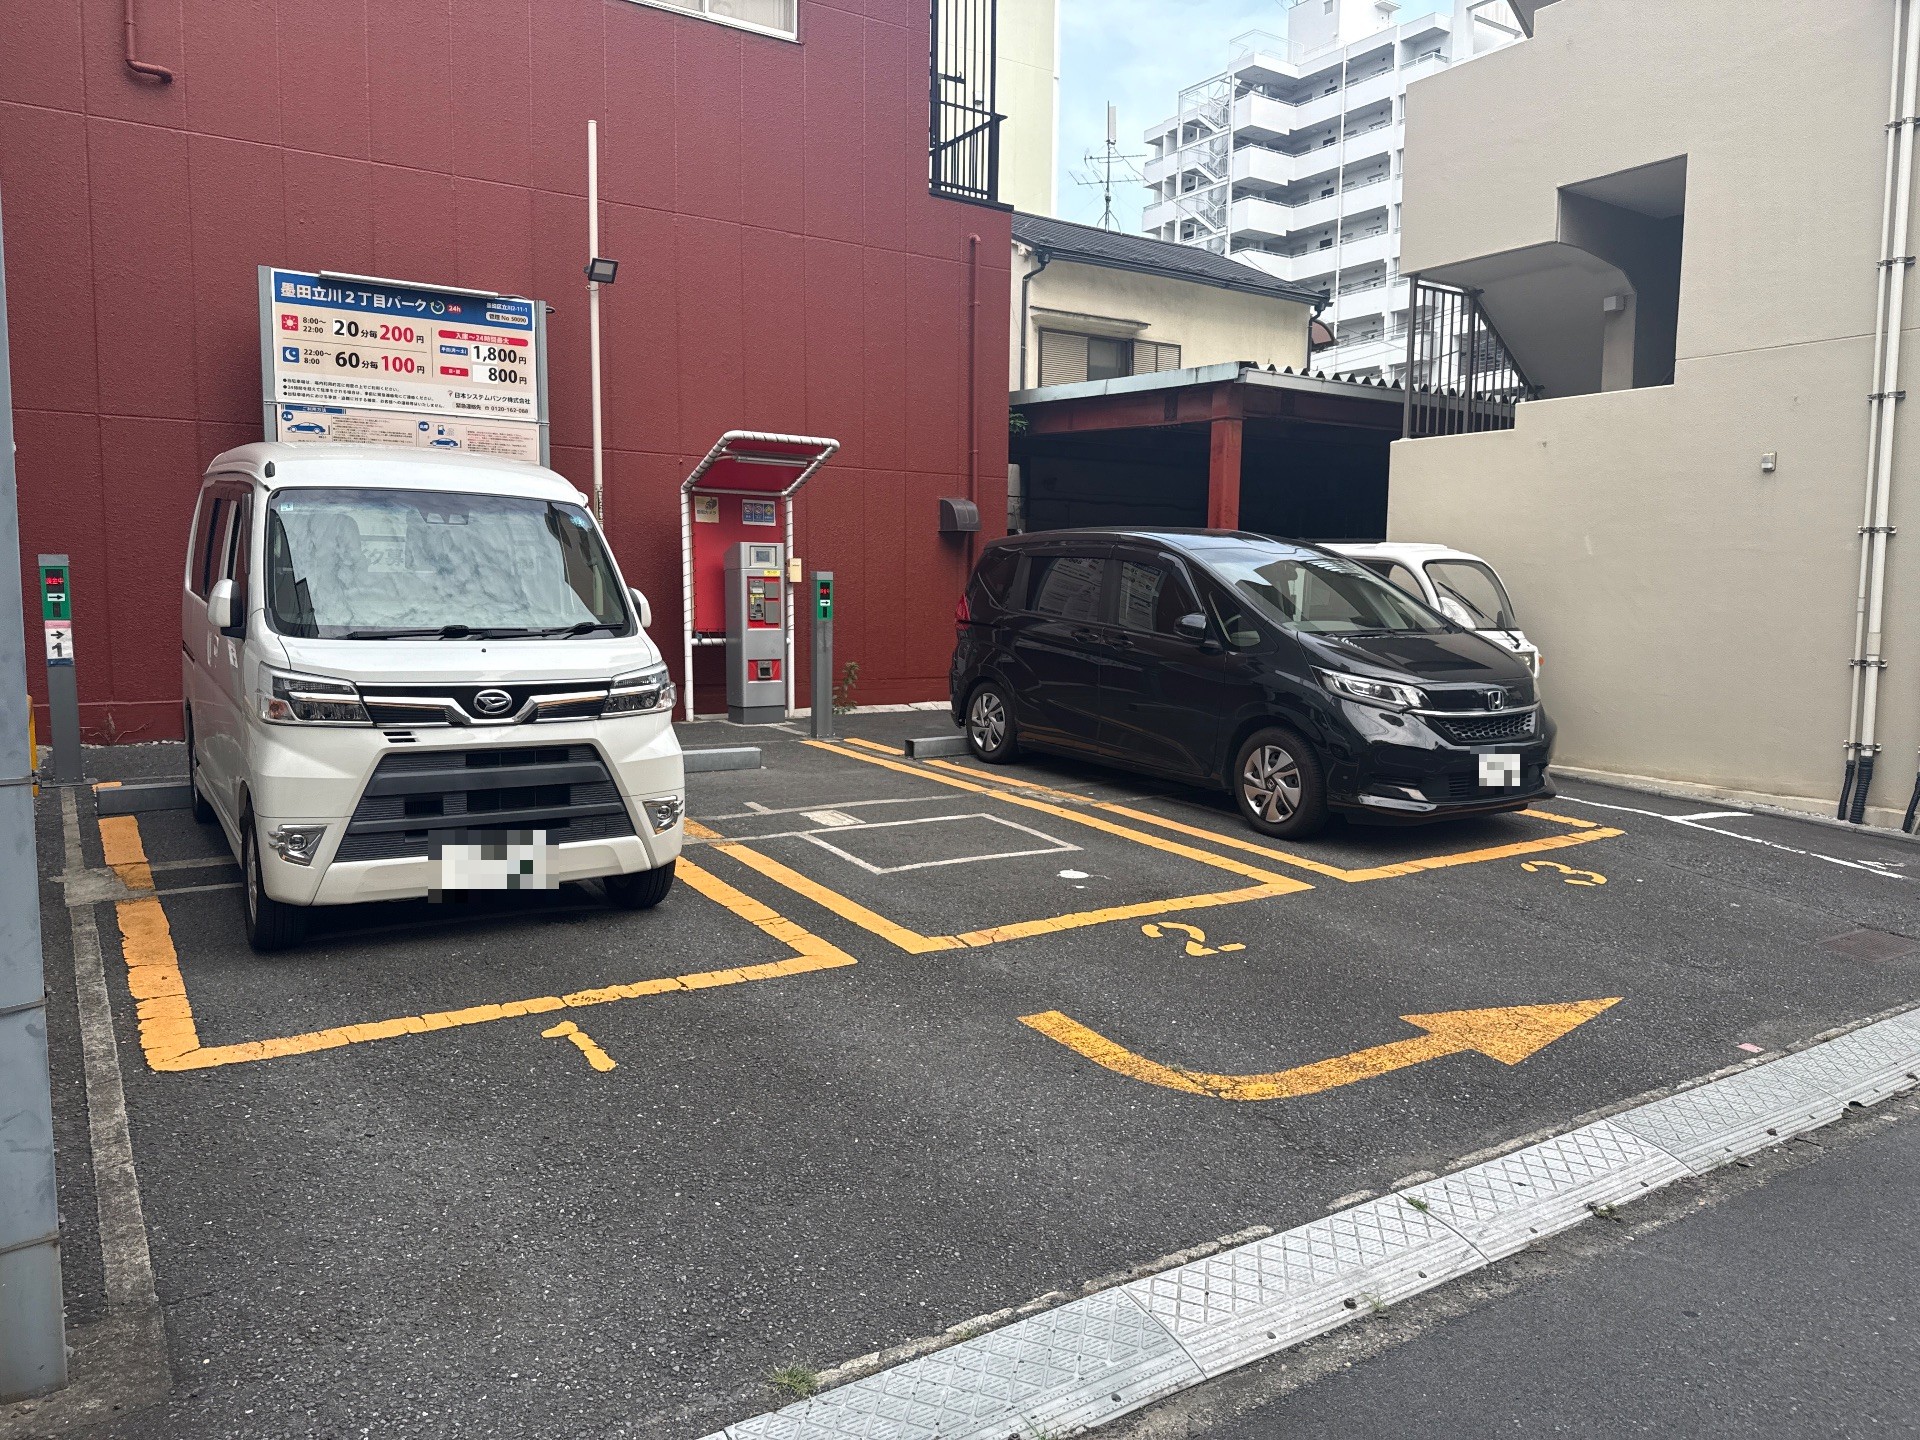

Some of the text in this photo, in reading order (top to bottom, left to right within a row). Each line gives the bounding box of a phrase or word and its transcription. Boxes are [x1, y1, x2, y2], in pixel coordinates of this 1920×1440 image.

[281, 281, 427, 312] 墨田立川2丁目パーク
[448, 304, 462, 313] 24h
[303, 325, 324, 334] 22:00
[304, 357, 320, 365] 8:00
[454, 391, 531, 405] 日本システムバンク株式会社
[52, 642, 63, 657] 1
[1520, 860, 1607, 886] 3
[1141, 920, 1247, 957] 2
[541, 1020, 616, 1072] 1
